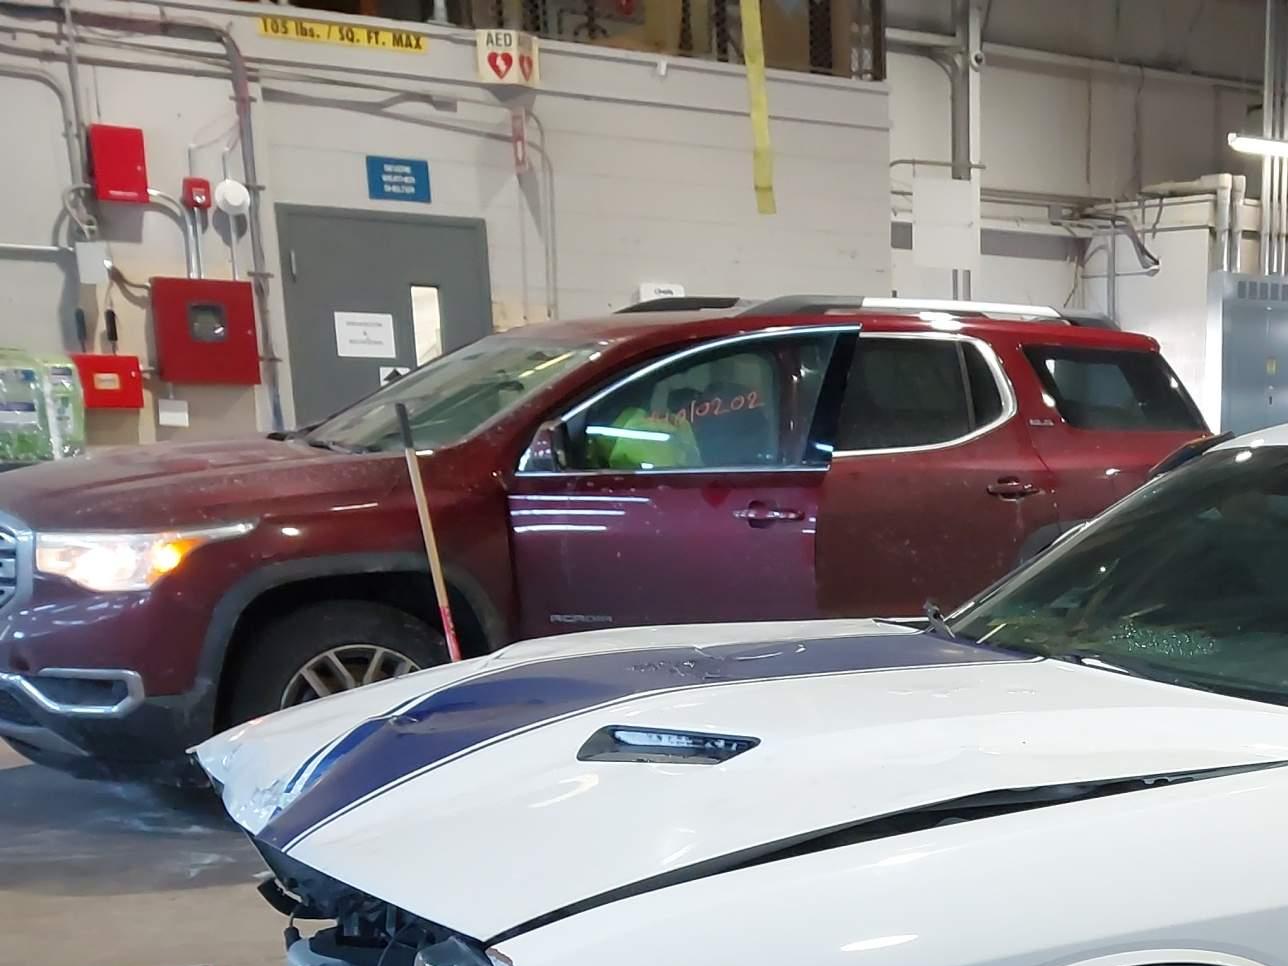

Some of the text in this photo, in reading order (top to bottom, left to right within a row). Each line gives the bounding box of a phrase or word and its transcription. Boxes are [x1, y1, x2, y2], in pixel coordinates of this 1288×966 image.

[295, 20, 320, 38] lbs.
[339, 26, 360, 43] SQ.
[367, 29, 386, 46] FT.
[392, 33, 423, 50] MAX
[486, 32, 513, 47] AED
